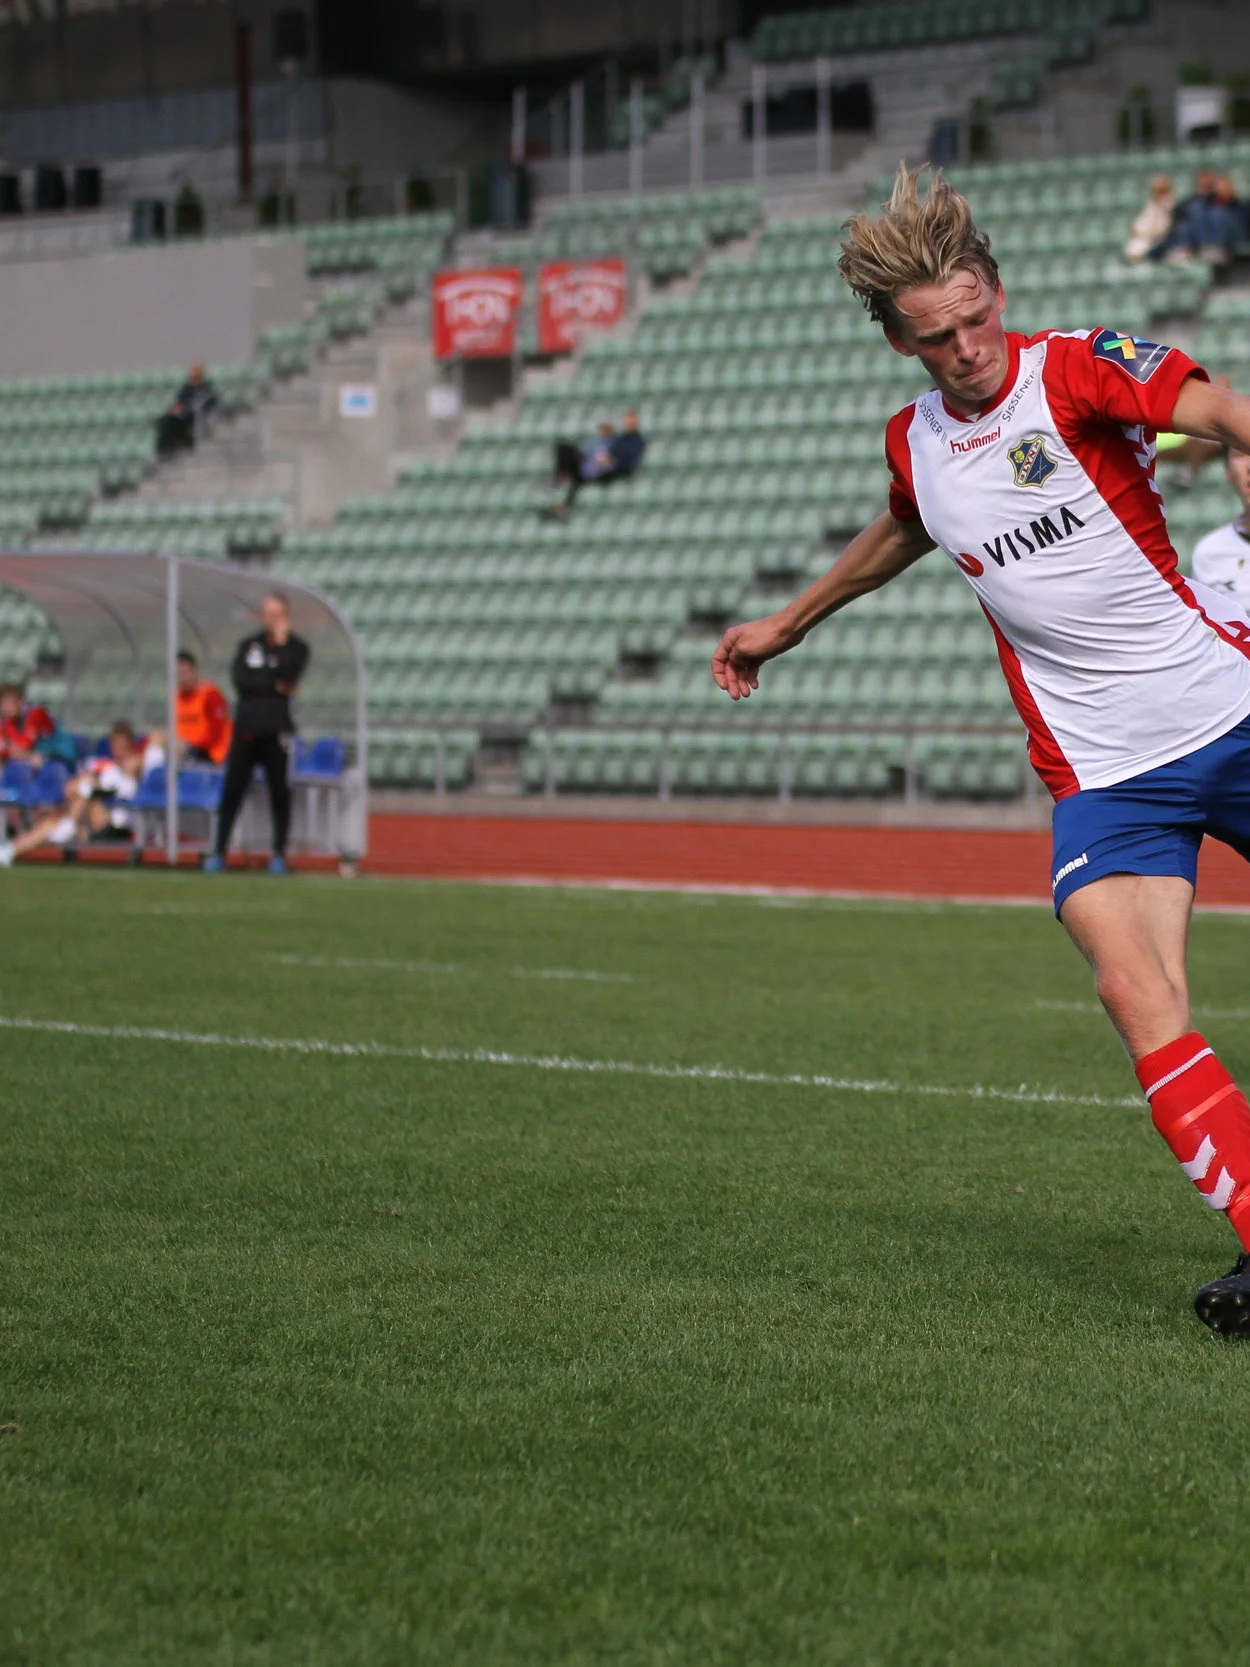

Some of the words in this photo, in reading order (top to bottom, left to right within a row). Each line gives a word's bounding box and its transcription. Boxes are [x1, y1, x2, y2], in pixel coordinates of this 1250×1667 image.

[919, 399, 943, 436] SISSENER
[950, 425, 1001, 455] hummel
[1022, 450, 1036, 473] LYN
[982, 506, 1086, 568] VISMA
[1052, 852, 1088, 891] ummel
